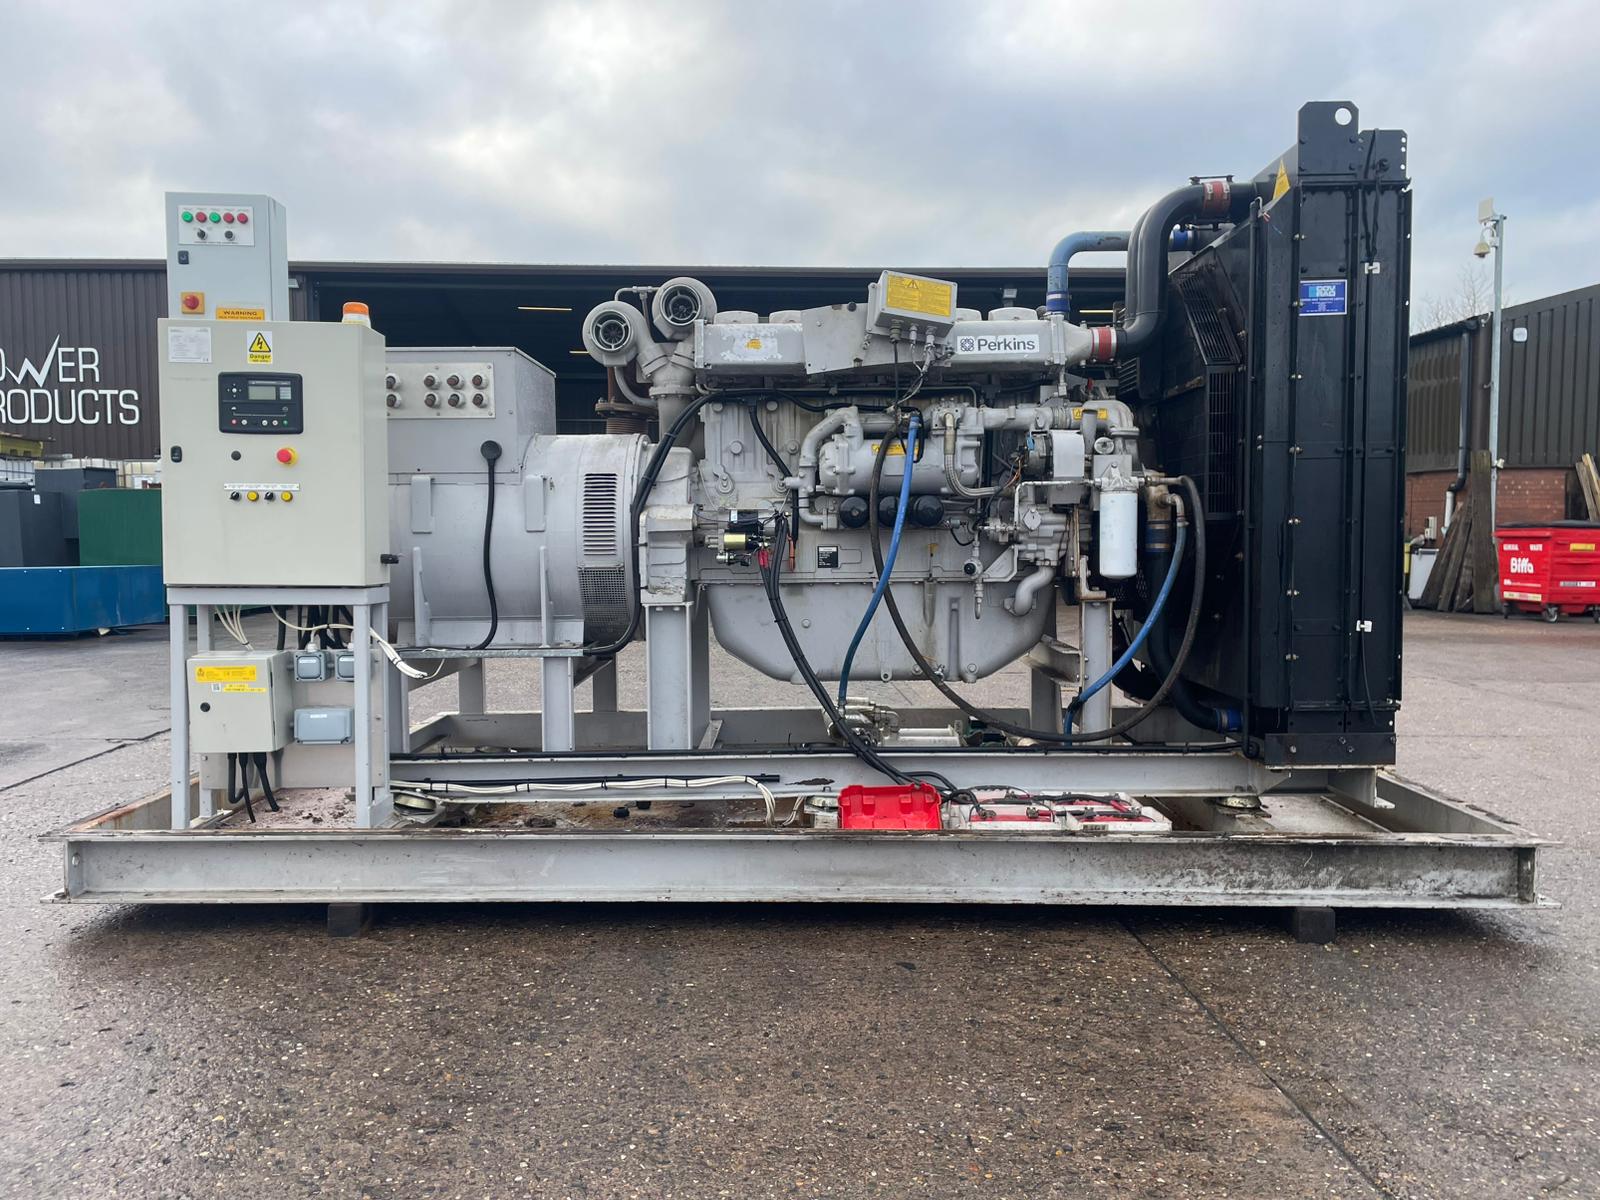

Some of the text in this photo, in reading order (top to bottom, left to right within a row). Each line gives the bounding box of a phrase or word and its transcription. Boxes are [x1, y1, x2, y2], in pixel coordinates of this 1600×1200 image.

[977, 338, 1035, 351] Perkins
[0, 334, 100, 388] WER
[1510, 557, 1534, 574] Biffa
